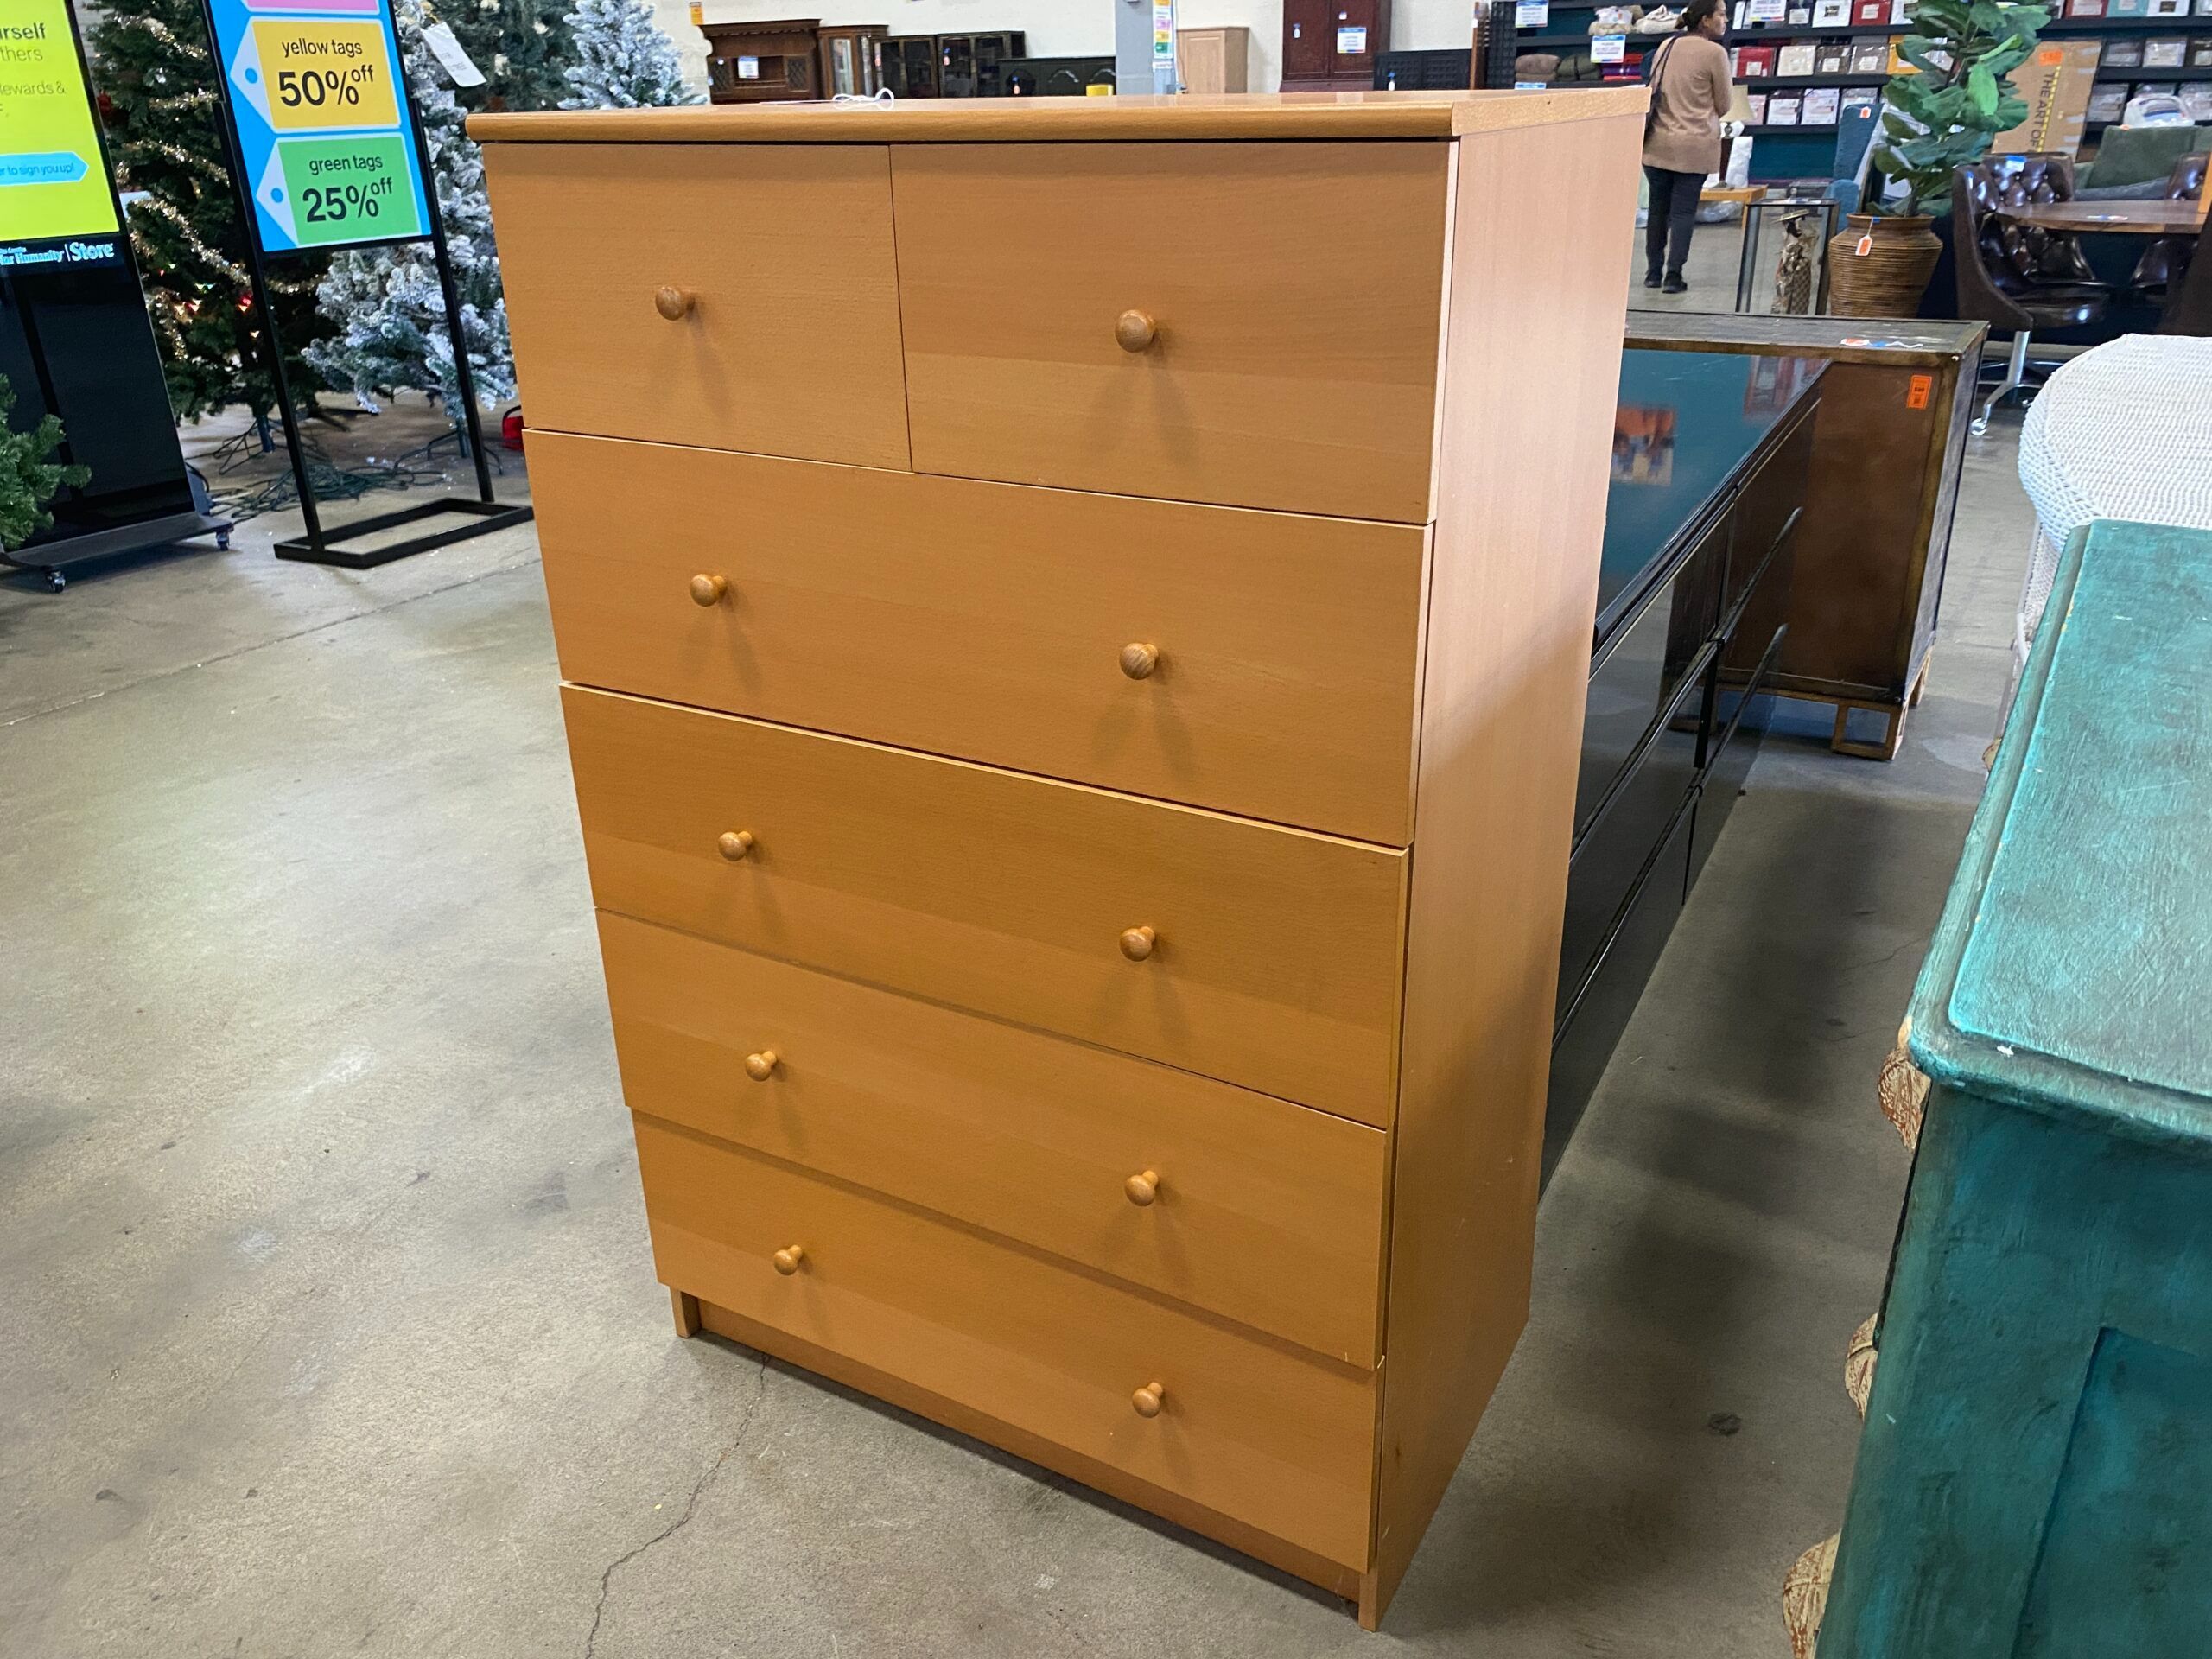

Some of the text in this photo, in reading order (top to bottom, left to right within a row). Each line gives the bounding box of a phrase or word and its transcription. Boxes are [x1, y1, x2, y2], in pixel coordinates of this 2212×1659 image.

[0, 22, 46, 41] rself
[281, 38, 363, 58] yellow tags
[278, 64, 374, 107] 50% off
[2040, 72, 2056, 98] THE
[2034, 100, 2048, 125] ART
[2029, 129, 2042, 147] OF
[40, 164, 59, 176] you
[309, 155, 384, 176] green tags
[302, 177, 393, 223] 25% off
[69, 242, 115, 261] Store
